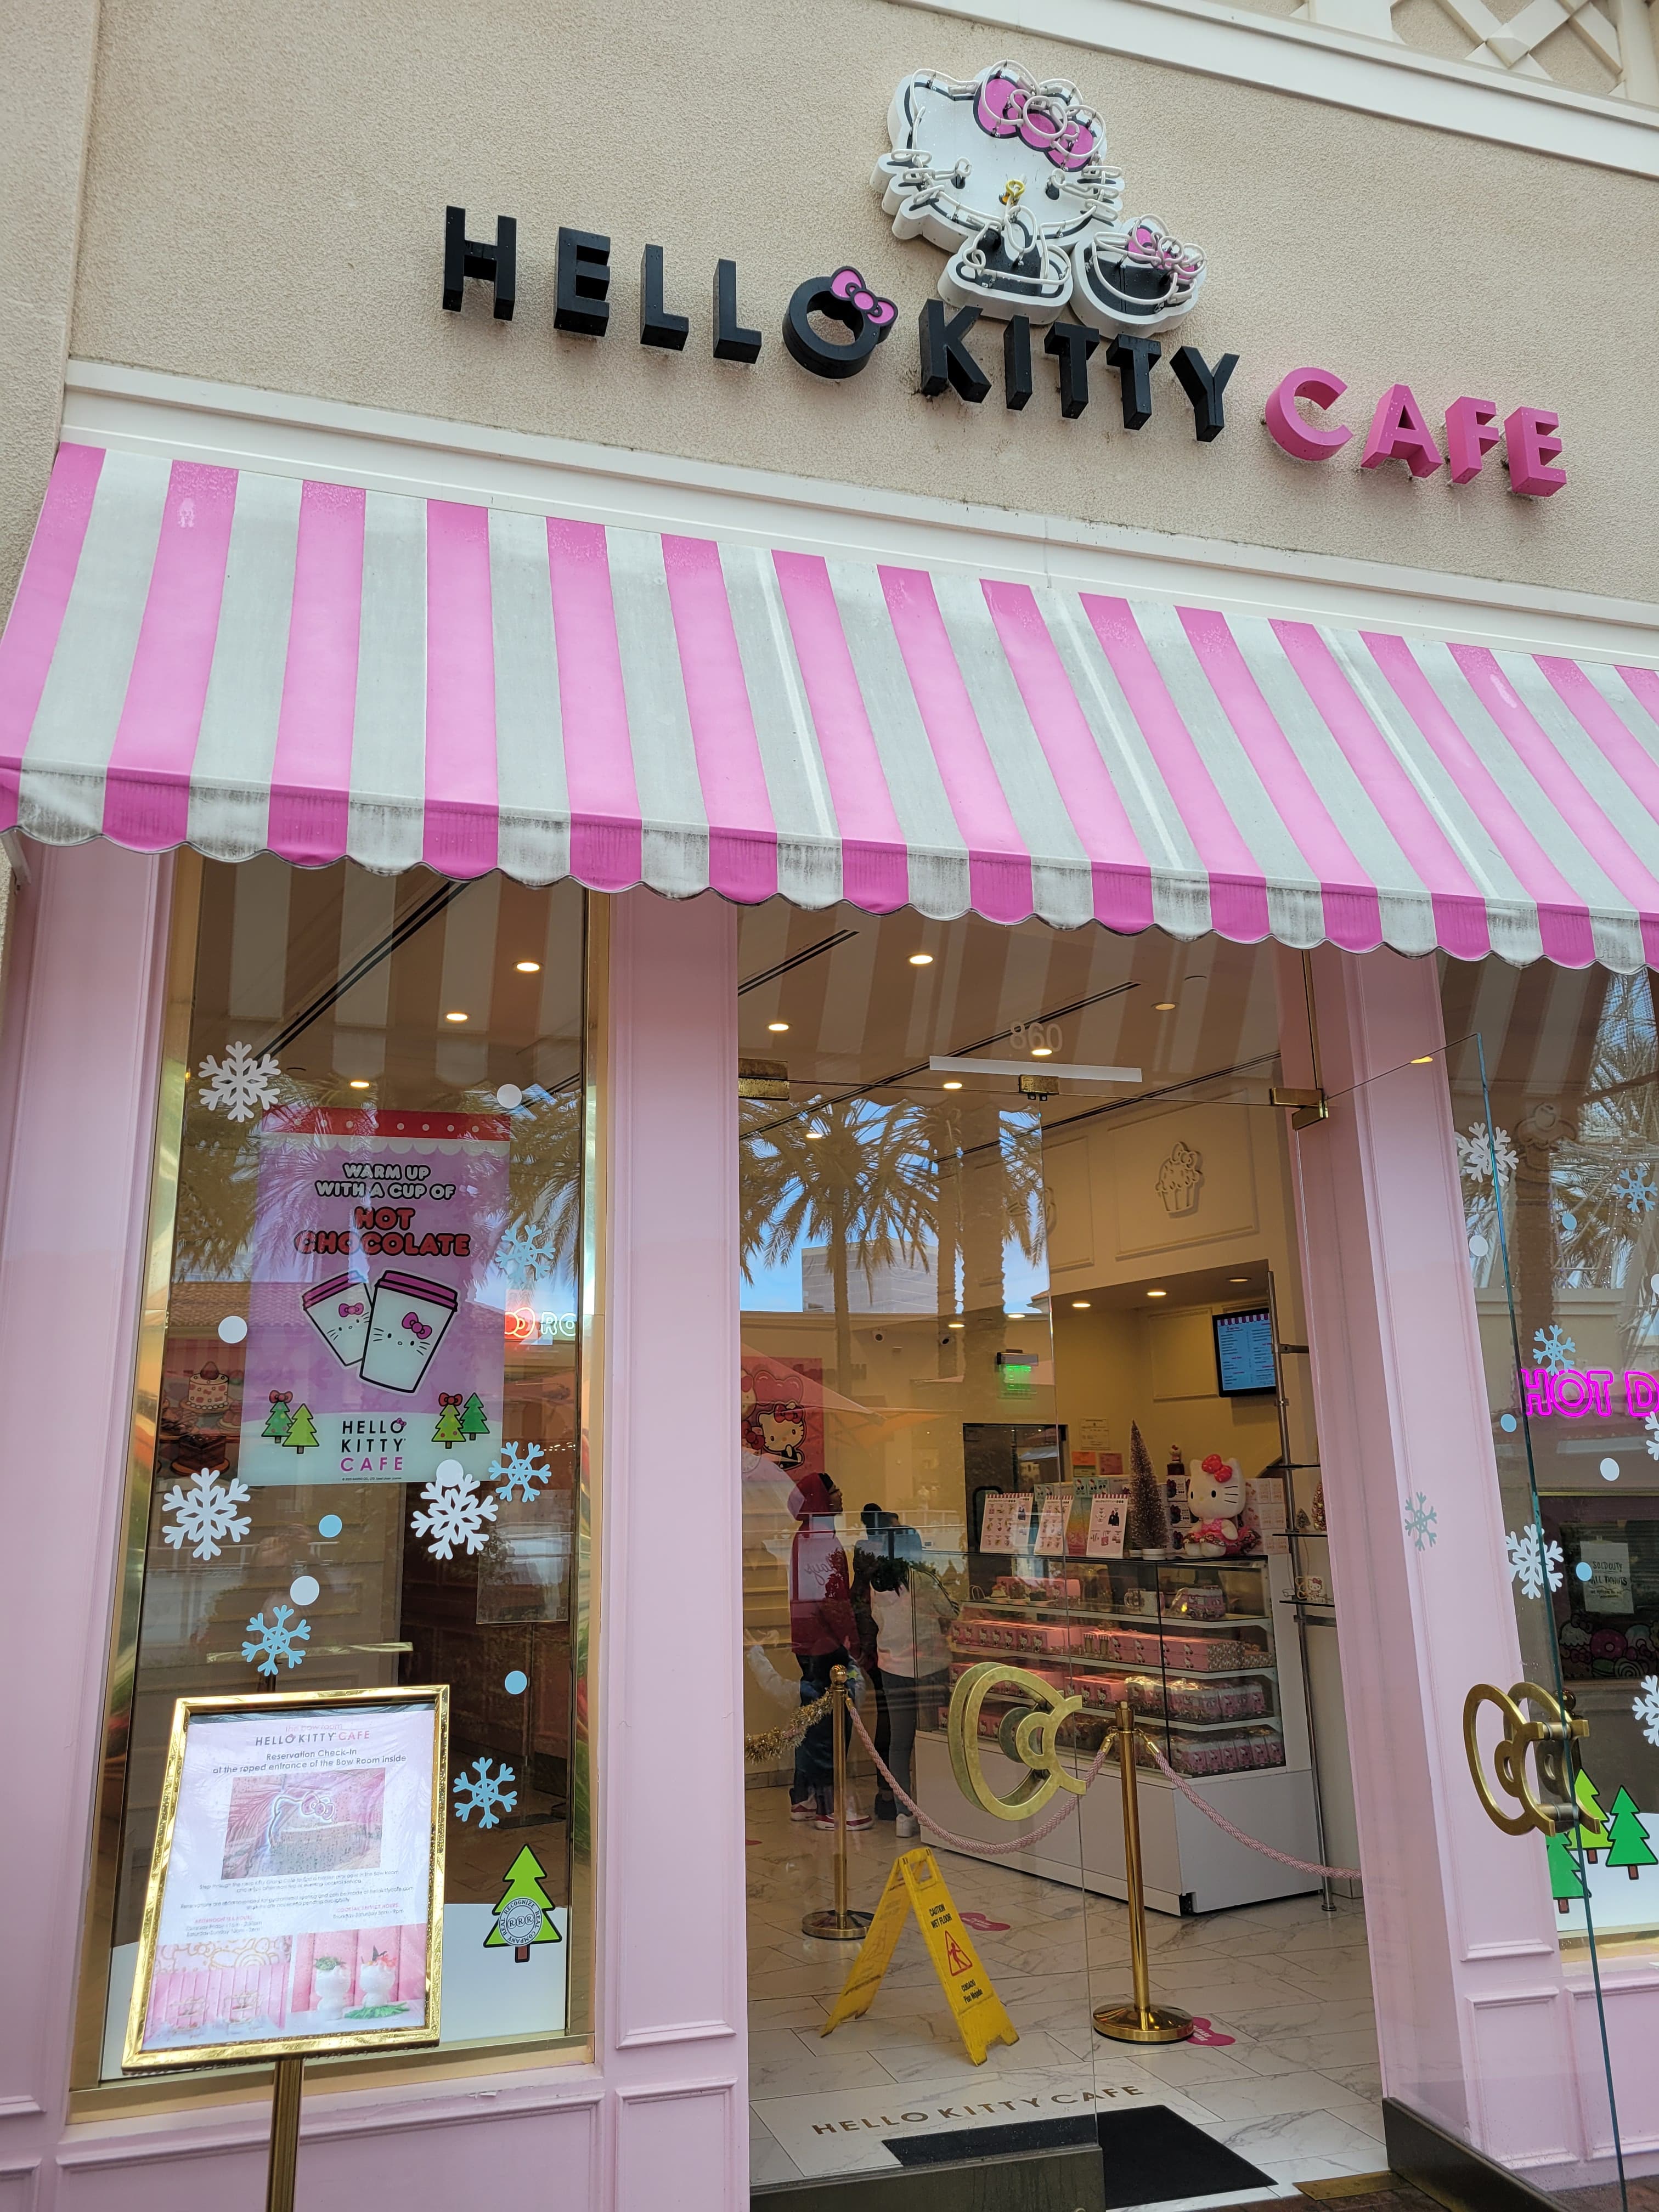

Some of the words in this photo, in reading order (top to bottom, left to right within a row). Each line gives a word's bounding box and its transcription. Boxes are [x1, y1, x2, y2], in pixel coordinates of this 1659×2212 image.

[443, 205, 898, 380] HELLO
[918, 298, 1239, 443] KITTY
[1264, 366, 1567, 497] CAFE
[1010, 1021, 1063, 1052] 860
[342, 1162, 402, 1180] WARM
[404, 1165, 431, 1181] UP
[315, 1180, 366, 1198] WITH
[369, 1181, 385, 1198] A
[388, 1182, 427, 1199] CUP
[429, 1183, 456, 1200] OF
[354, 1206, 416, 1231] HOT
[294, 1230, 471, 1257] CHOCOLATE
[1521, 1369, 1613, 1417] HOT
[342, 1418, 406, 1434] HELLO
[341, 1438, 404, 1453] KITTY
[341, 1457, 403, 1471] CAFE
[256, 1734, 296, 1746] HELLO
[298, 1733, 336, 1742] KITTY
[338, 1730, 370, 1741] CAFE
[267, 1751, 315, 1760] Reservation
[318, 1748, 357, 1757] Check-In
[240, 1764, 266, 1773] roped
[269, 1762, 307, 1770] entrance
[382, 1754, 407, 1763] inside
[504, 1899, 535, 1915] RECOGNIZE
[929, 1903, 946, 1917] CAUTION
[930, 1919, 940, 1929] WET
[939, 1913, 953, 1926] FLOOR
[507, 1931, 536, 1944] COMPANY
[963, 1993, 972, 2004] Piso
[812, 2111, 929, 2135] HELLO
[936, 2097, 1041, 2119] KITTY
[1050, 2085, 1144, 2104] CAFE
